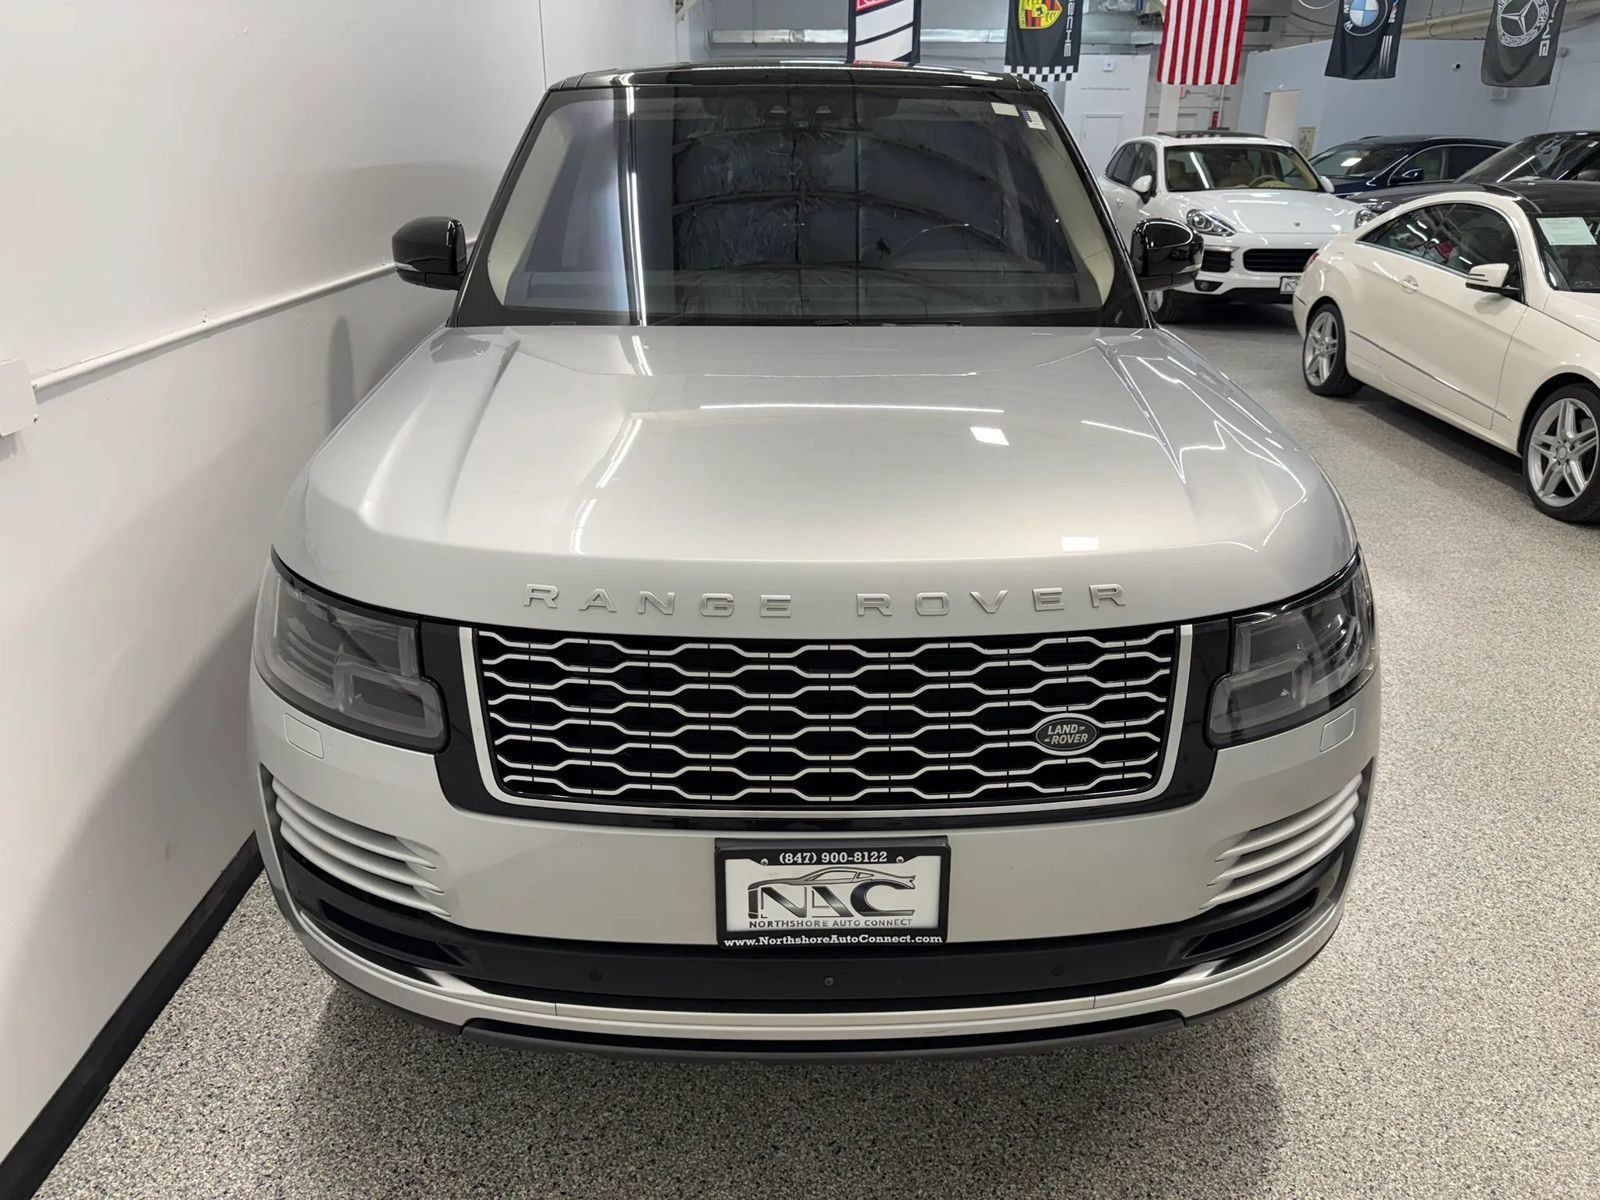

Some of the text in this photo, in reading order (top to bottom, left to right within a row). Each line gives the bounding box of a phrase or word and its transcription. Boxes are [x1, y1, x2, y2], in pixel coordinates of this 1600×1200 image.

[523, 583, 1127, 618] RANGE ROVER
[1047, 724, 1079, 735] LAND
[1050, 733, 1089, 745] ROVER
[779, 851, 887, 864] (847) 900-8122
[748, 881, 915, 919] NAC
[749, 918, 913, 929] NORTHSHORE AUTO CONNECT
[723, 934, 943, 947] www.NorthshoreAutoConnect.com
